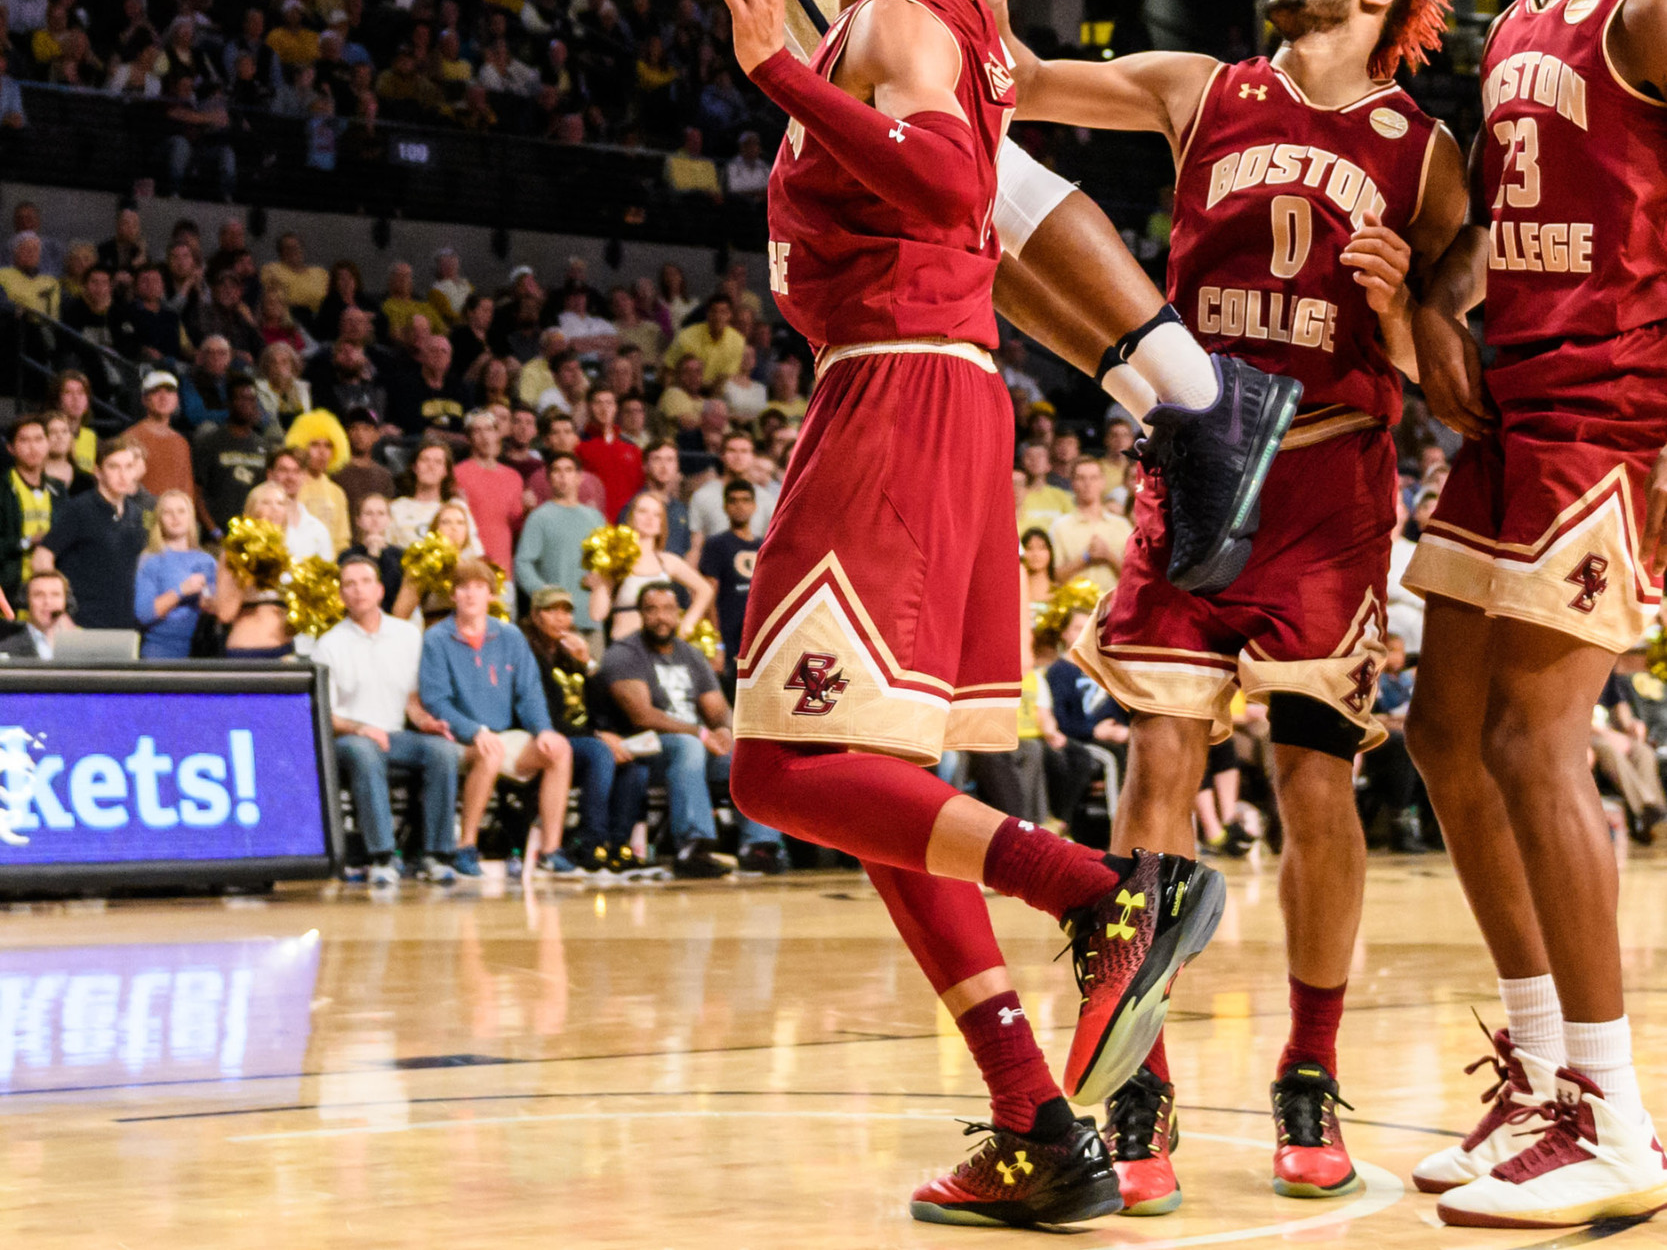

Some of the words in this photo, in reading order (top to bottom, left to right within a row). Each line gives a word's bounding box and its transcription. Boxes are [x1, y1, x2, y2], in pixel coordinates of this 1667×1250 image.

[1205, 142, 1388, 233] BOSTON
[1491, 116, 1542, 209] 23
[1270, 194, 1313, 280] 0
